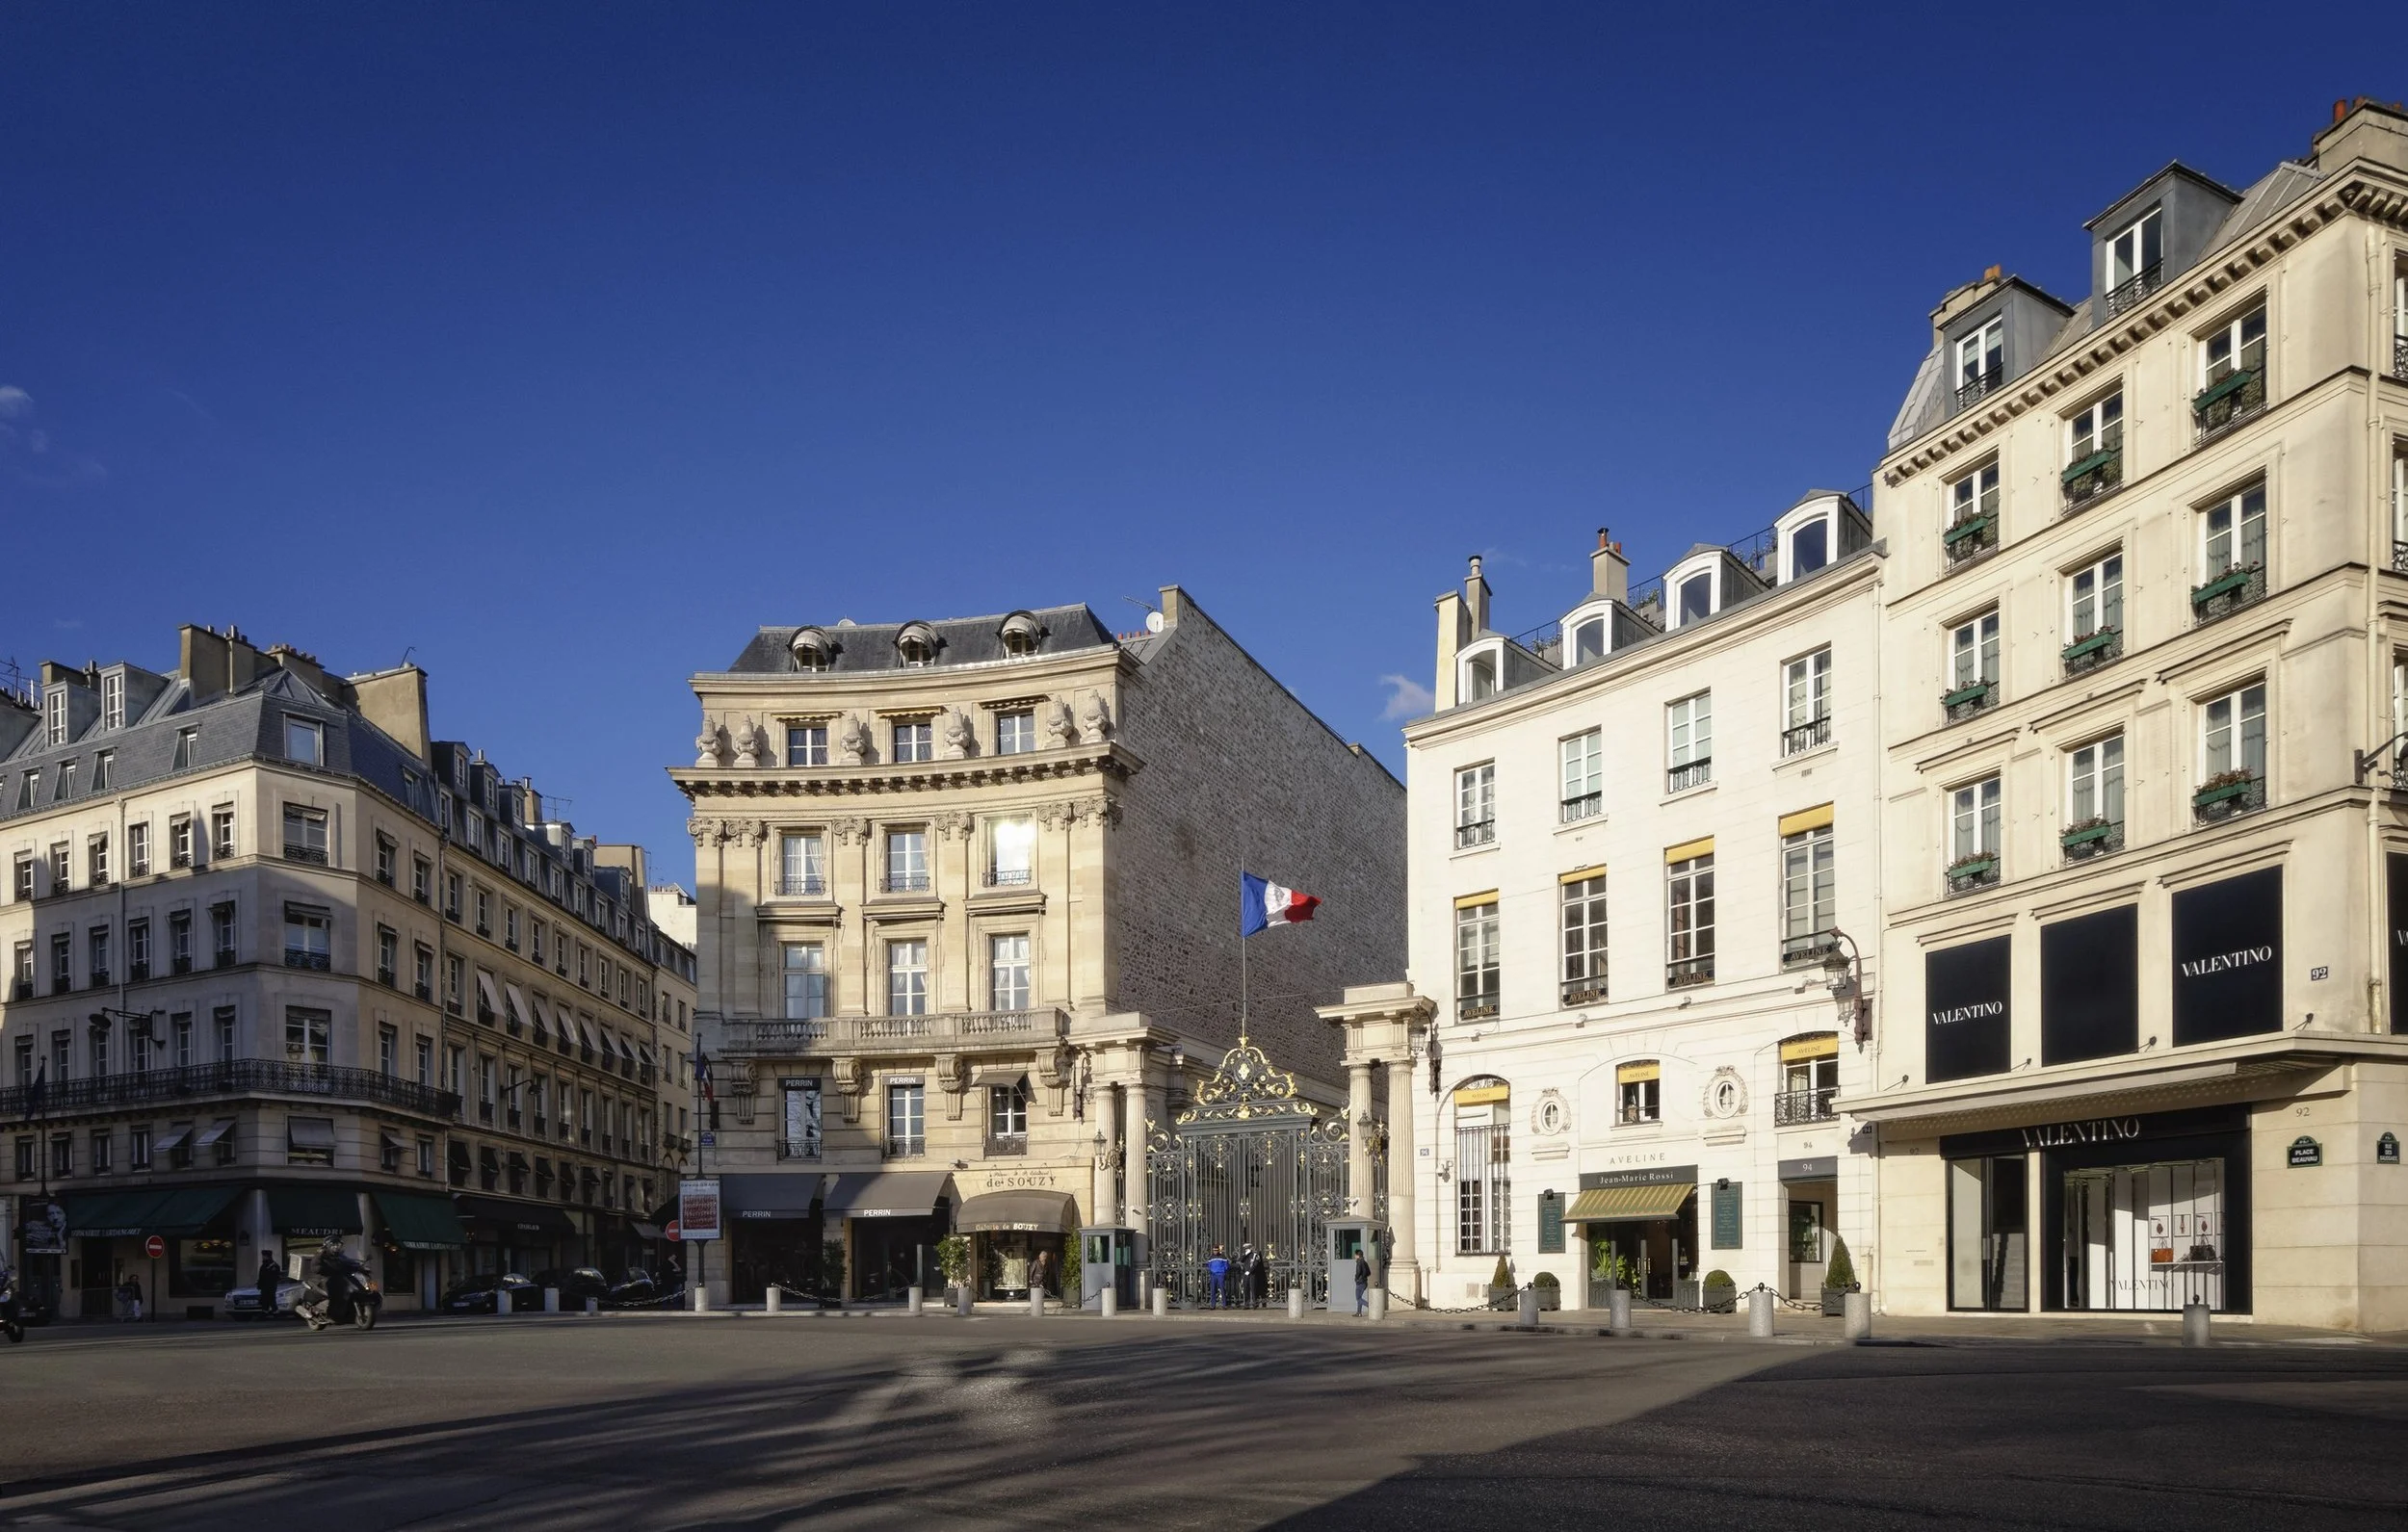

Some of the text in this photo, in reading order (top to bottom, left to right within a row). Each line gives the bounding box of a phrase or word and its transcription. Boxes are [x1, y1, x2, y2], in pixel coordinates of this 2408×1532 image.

[1791, 947, 1827, 960] AVELINE
[2182, 946, 2272, 977] VALENTINO
[1674, 972, 1709, 984] AVELINE
[2313, 968, 2326, 979] 92
[1569, 989, 1601, 1001] AVELINE
[1464, 1005, 1494, 1017] AVELINE
[1932, 1000, 2002, 1026] VALENTINO
[2296, 1107, 2310, 1117] 92
[2021, 1118, 2140, 1148] VALENTINO
[1909, 1147, 1920, 1155] 92
[1610, 1153, 1665, 1165] AVELINE
[1802, 1163, 1813, 1172] 94
[986, 1176, 1057, 1187] de SOUZY
[1599, 1171, 1674, 1184] Jean-Marie Rossi
[2109, 1279, 2175, 1290] VALENTINO
